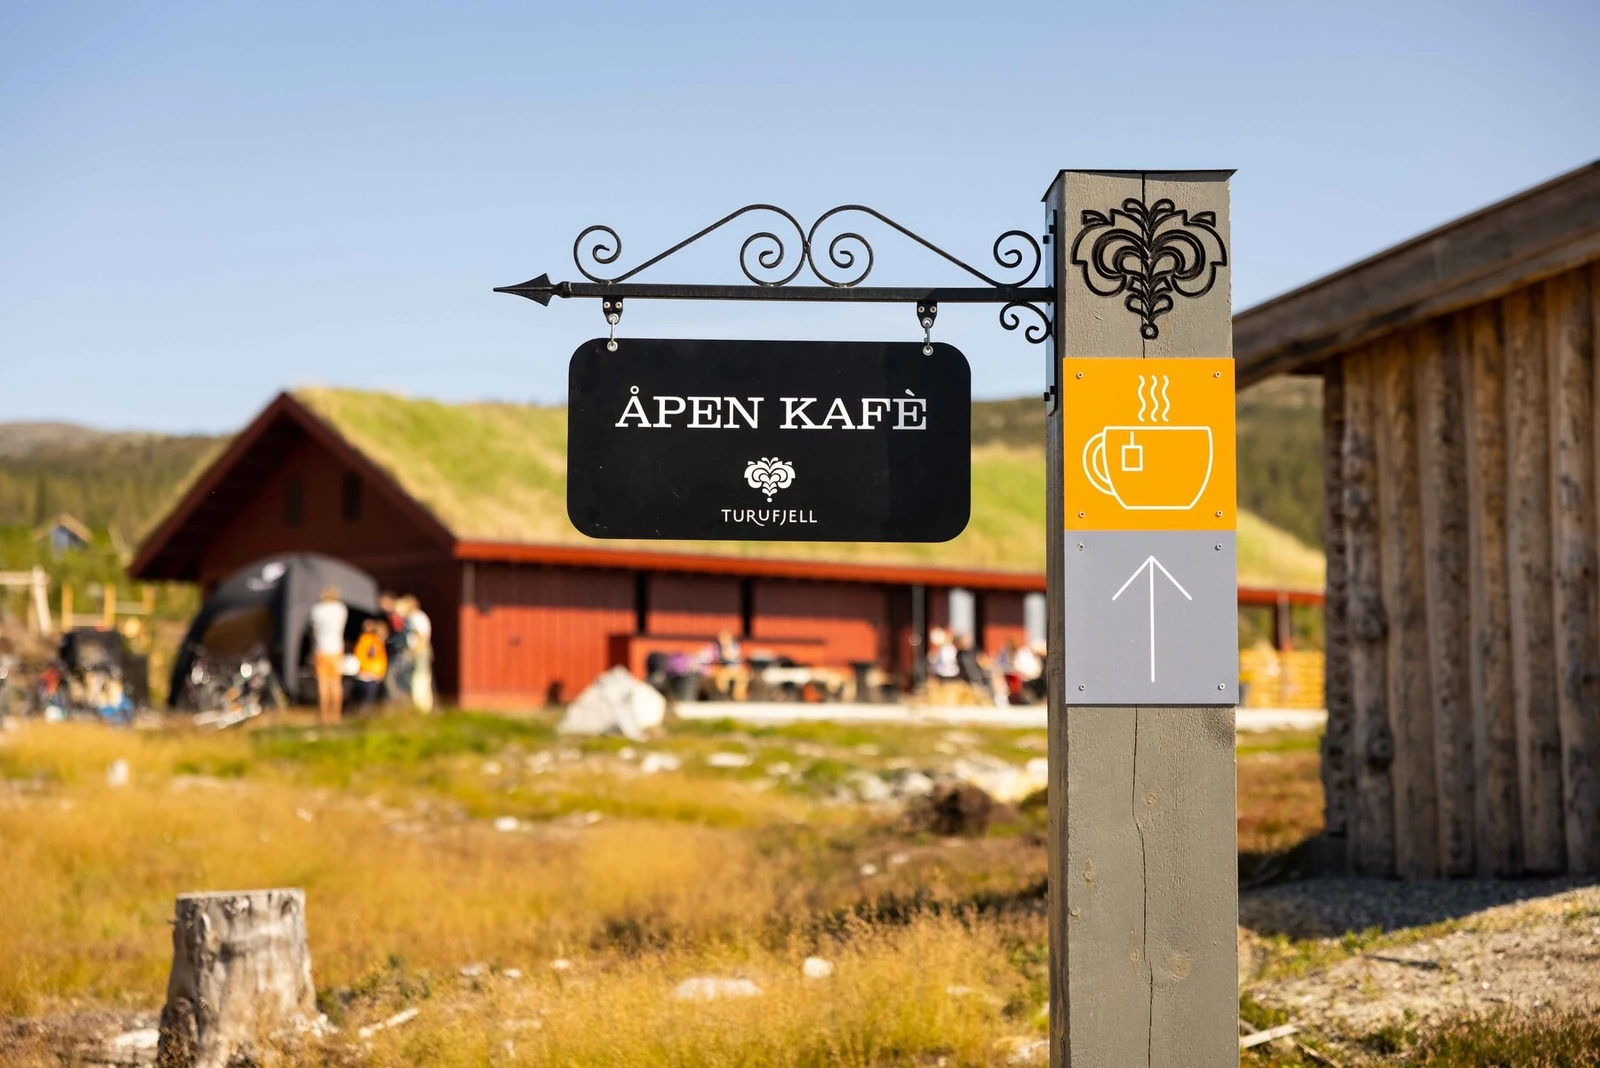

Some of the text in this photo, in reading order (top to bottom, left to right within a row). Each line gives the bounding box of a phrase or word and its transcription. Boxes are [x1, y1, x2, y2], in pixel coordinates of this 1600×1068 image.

[614, 385, 927, 430] ÅPEN KAFÈ
[721, 509, 818, 527] TURUFJELL
